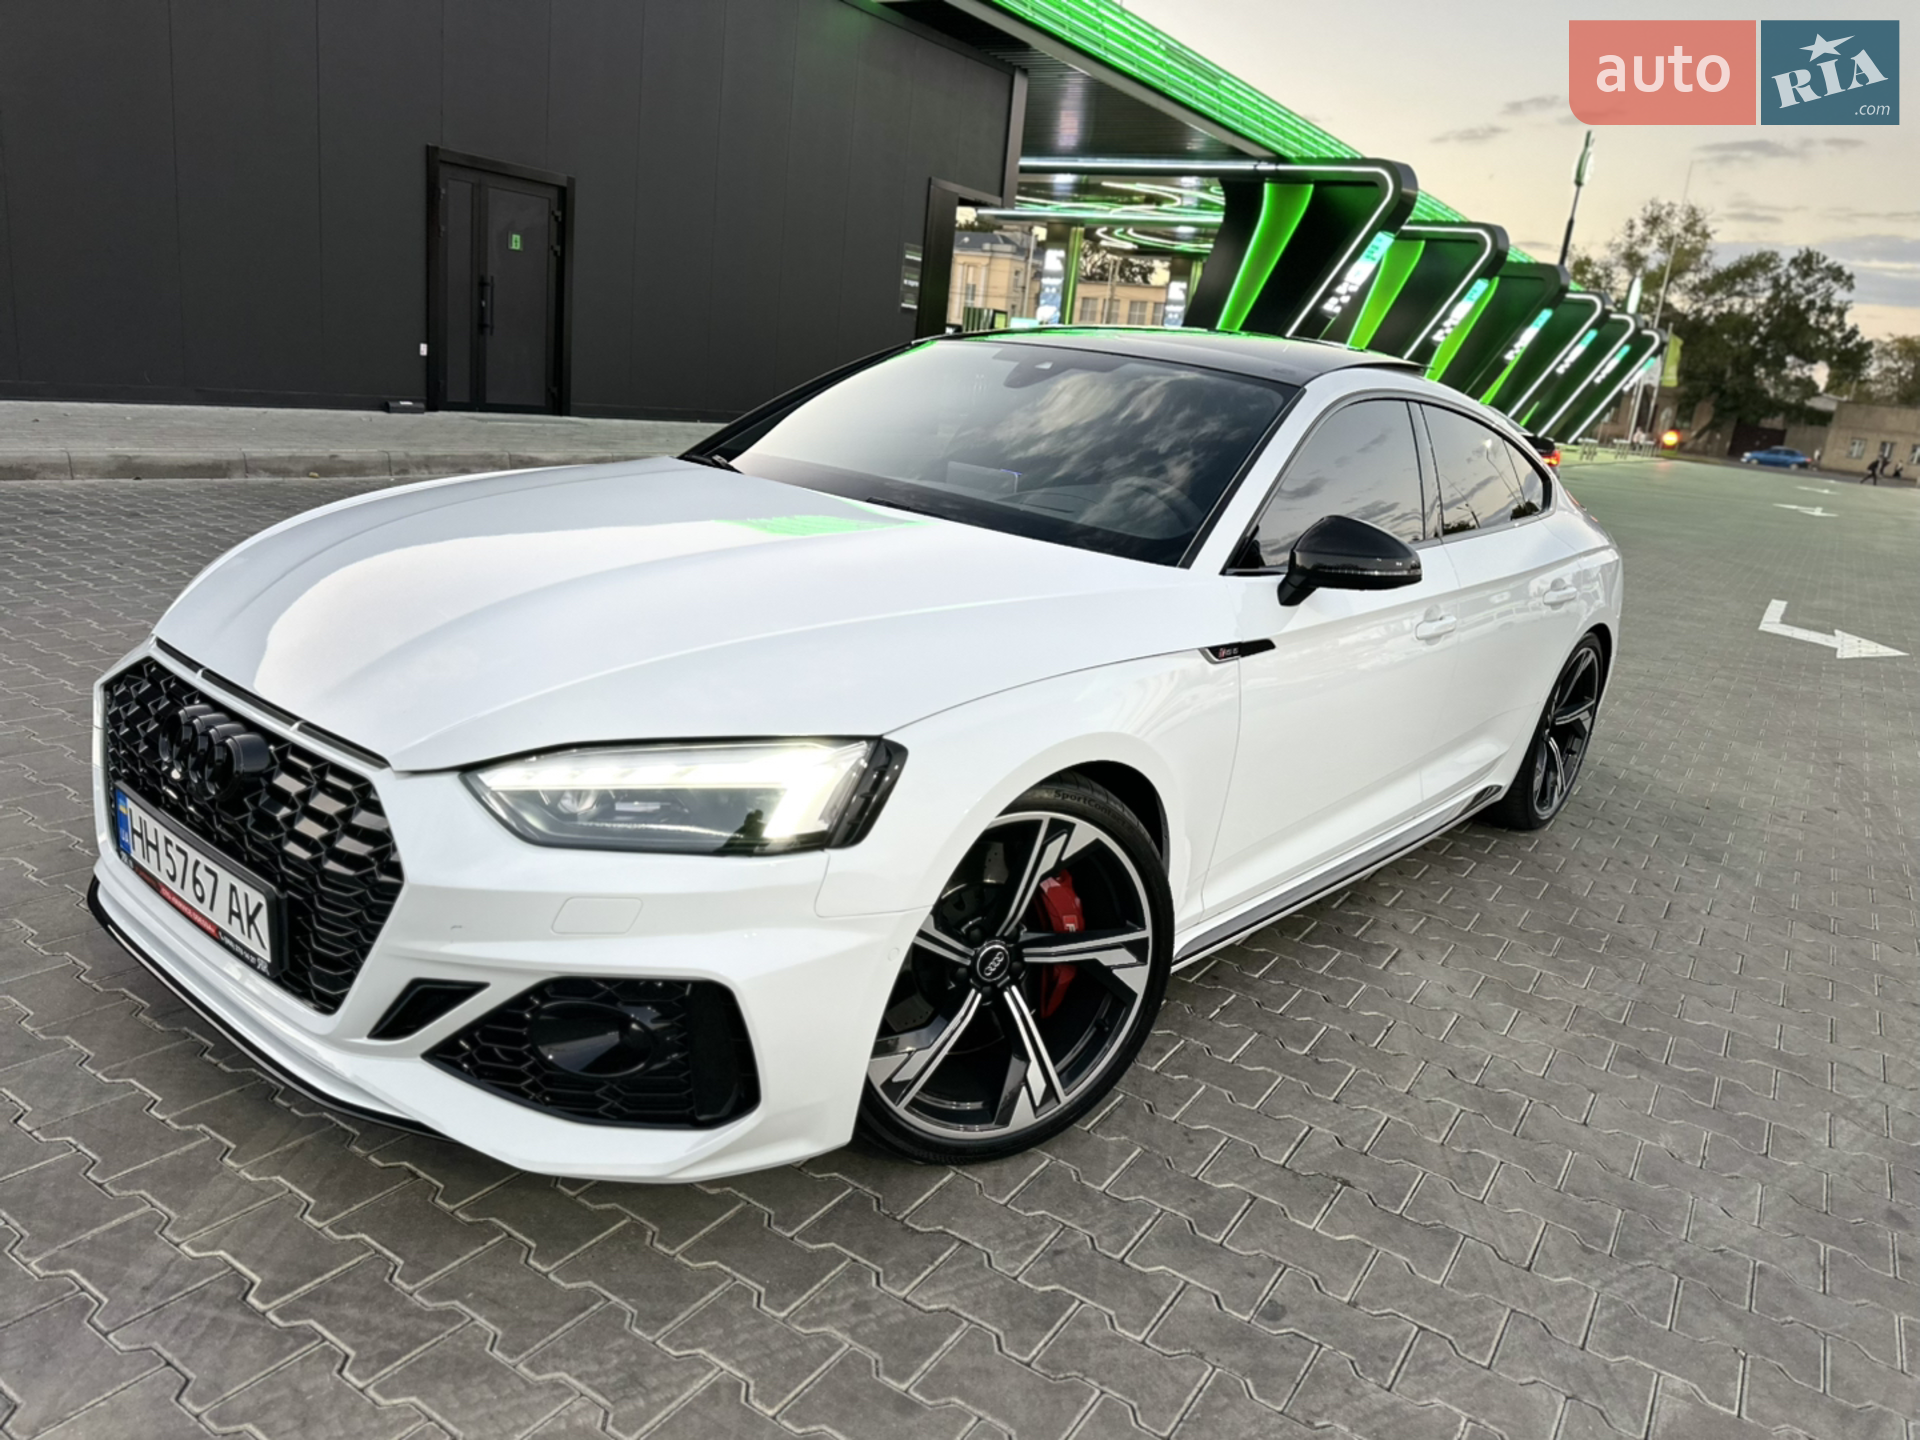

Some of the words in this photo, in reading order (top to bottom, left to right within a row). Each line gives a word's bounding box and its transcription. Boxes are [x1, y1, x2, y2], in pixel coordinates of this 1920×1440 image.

[129, 808, 161, 872] HH
[164, 836, 219, 912] 5767
[228, 882, 267, 950] AK
